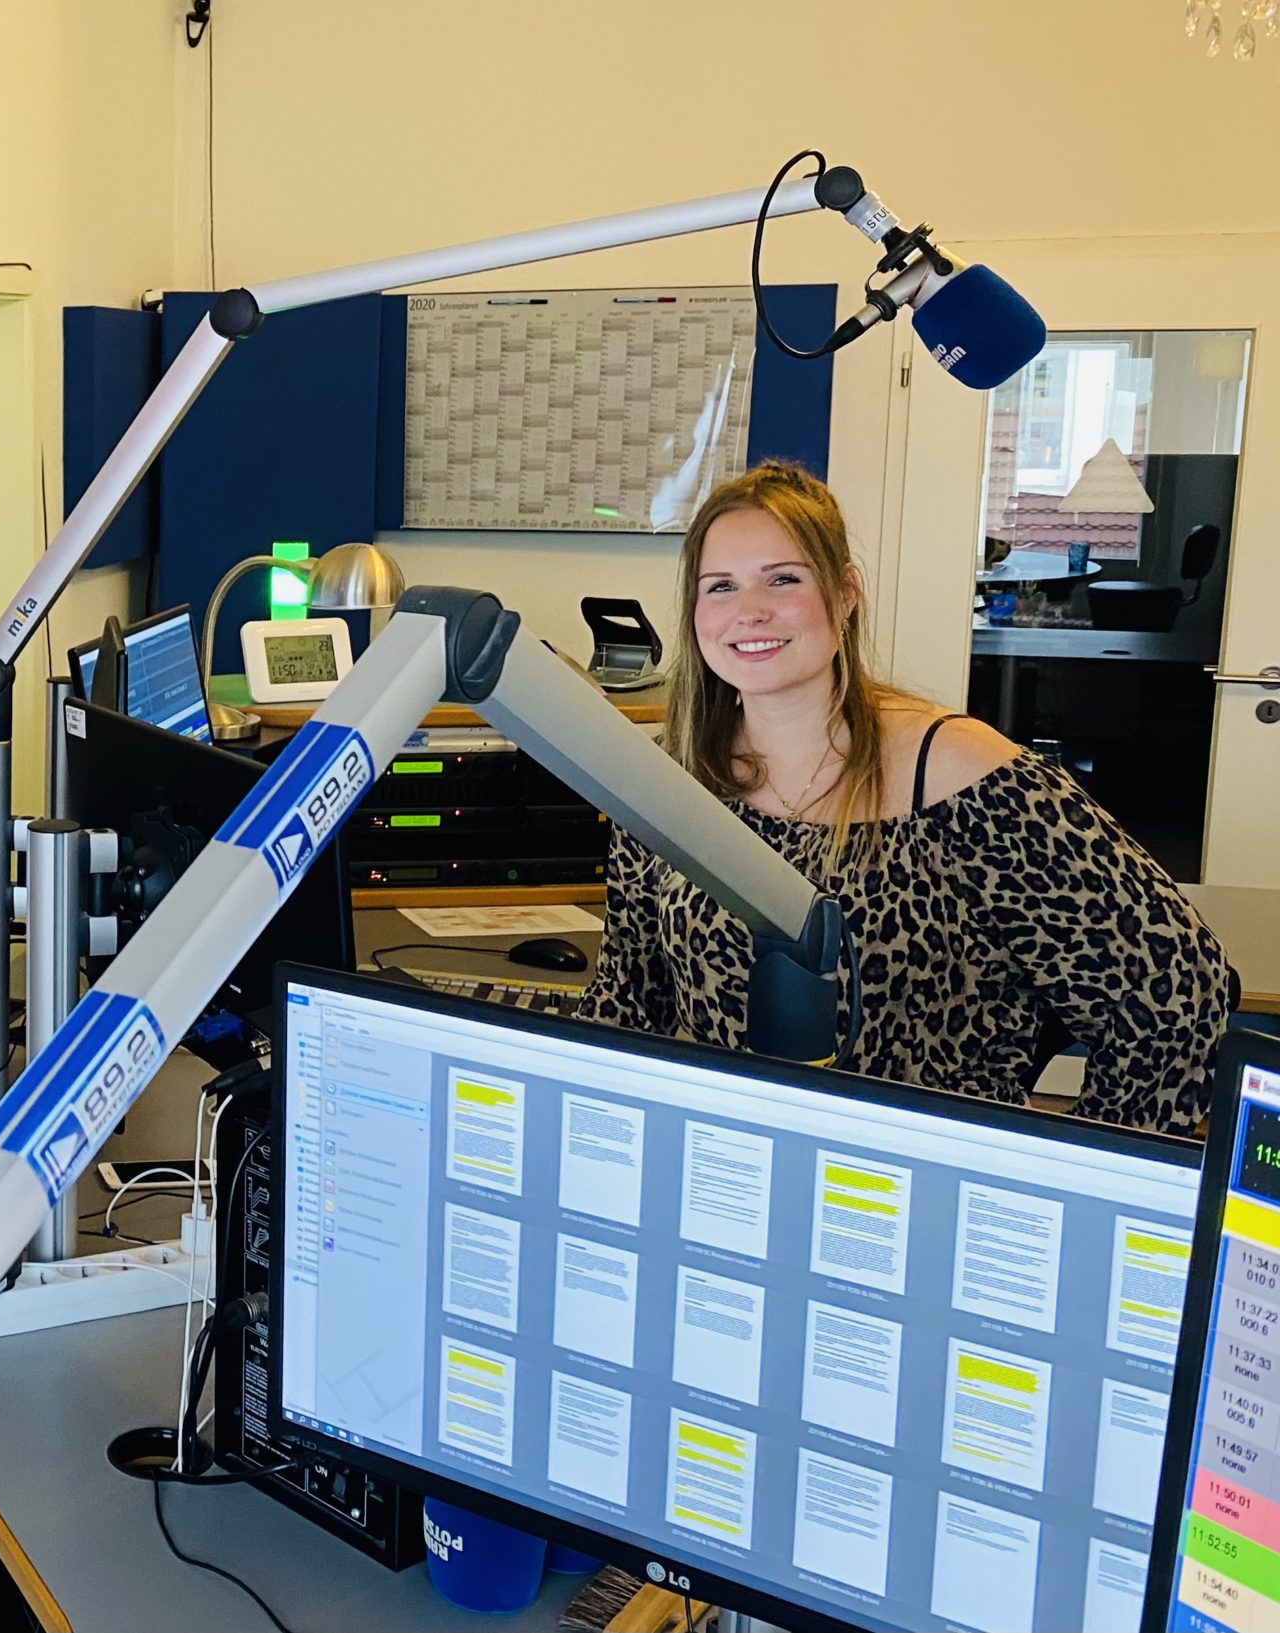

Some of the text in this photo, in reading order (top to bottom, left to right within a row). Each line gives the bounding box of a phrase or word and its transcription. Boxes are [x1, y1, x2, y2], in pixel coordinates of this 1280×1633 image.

[409, 298, 436, 311] 2020
[308, 751, 363, 826] 89.2
[317, 768, 367, 839] POTSDAM
[84, 1029, 151, 1122] 89.2
[94, 1048, 157, 1134] POTSDAM
[1234, 1364, 1260, 1382] none
[1221, 1455, 1247, 1474] none
[1215, 1501, 1240, 1520] none
[1192, 1526, 1239, 1560] 11:52:55
[669, 1571, 690, 1590] LG
[1202, 1591, 1227, 1610] none
